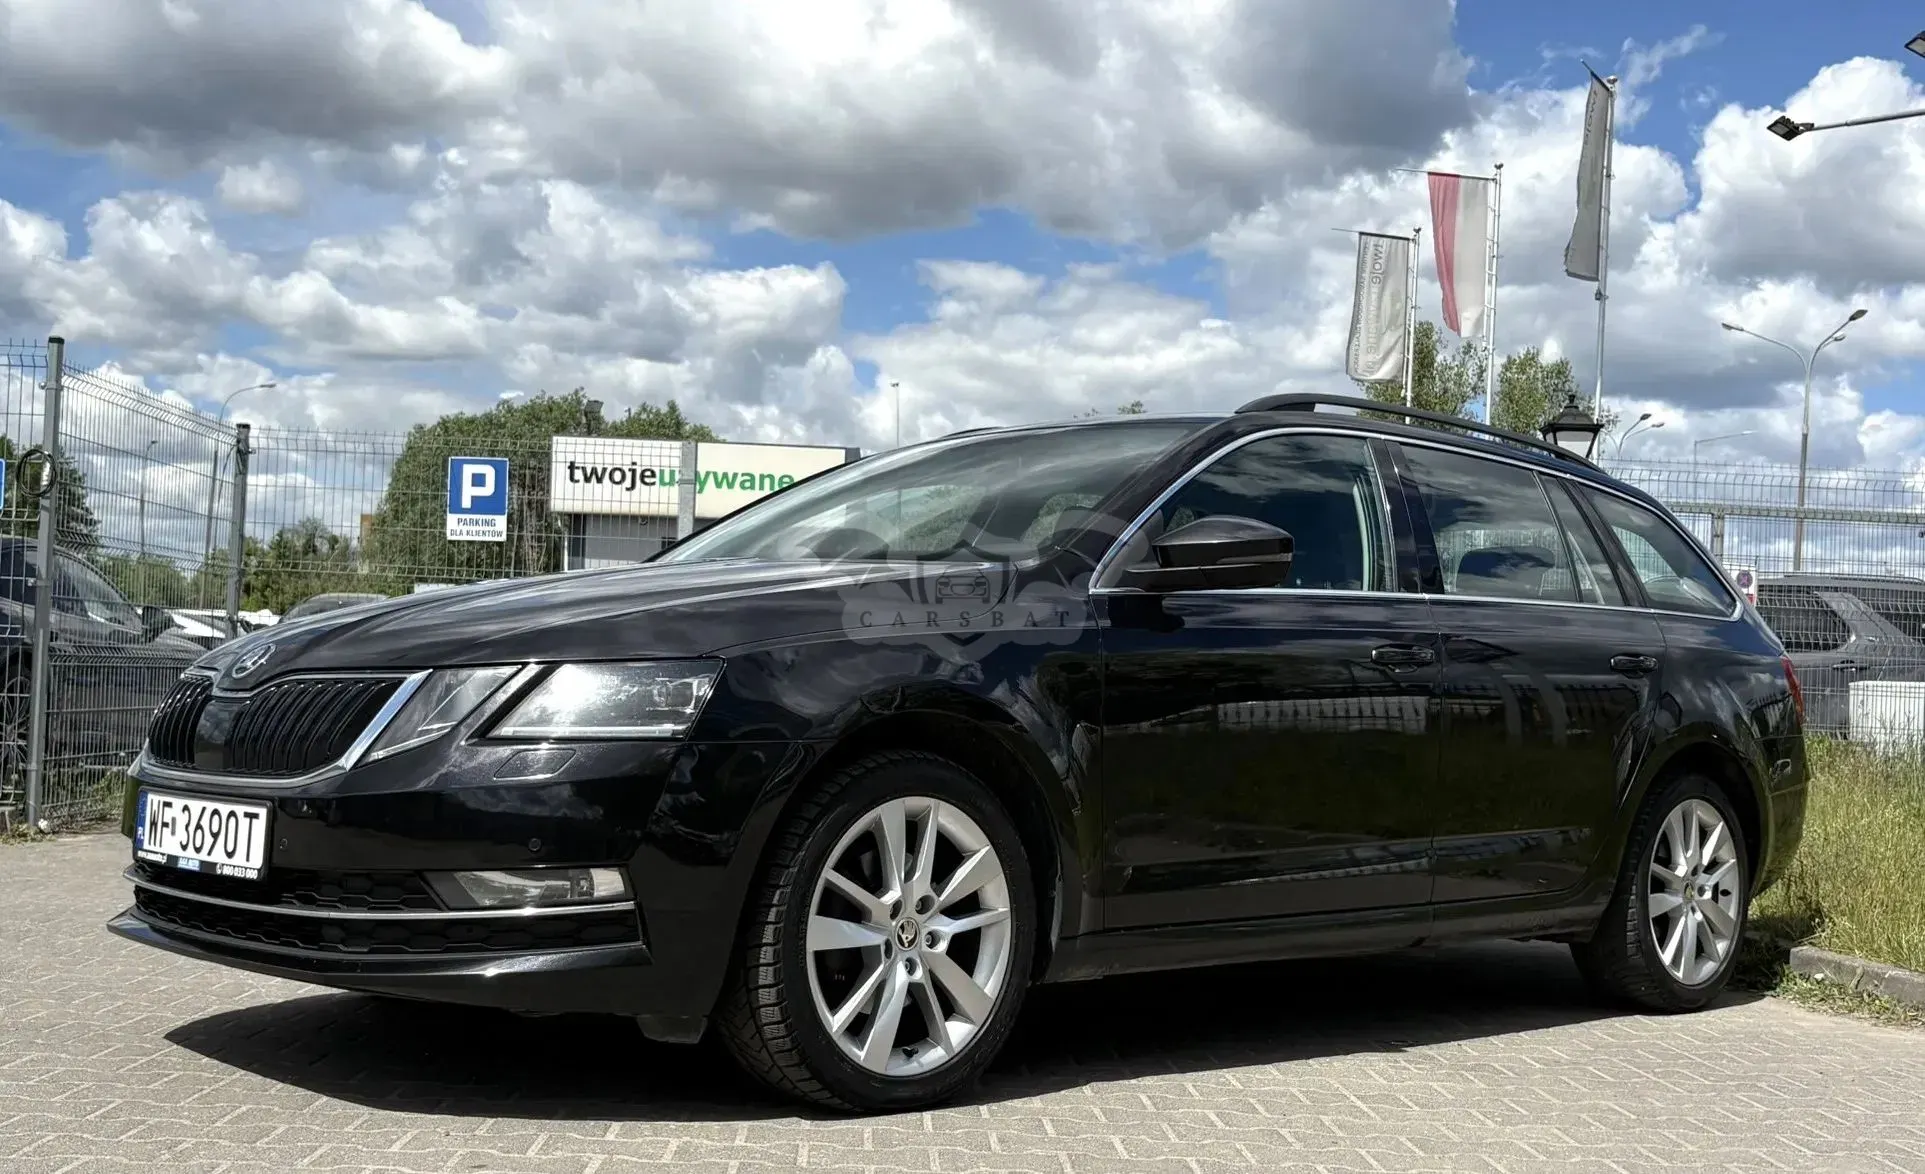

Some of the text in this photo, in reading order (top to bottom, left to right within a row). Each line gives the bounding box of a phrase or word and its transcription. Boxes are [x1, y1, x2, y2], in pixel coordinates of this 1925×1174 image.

[461, 463, 496, 509] P
[567, 461, 795, 494] twojeuywane
[450, 528, 464, 537] DLA
[457, 517, 497, 528] PARKING
[148, 798, 260, 863] WF 3690T
